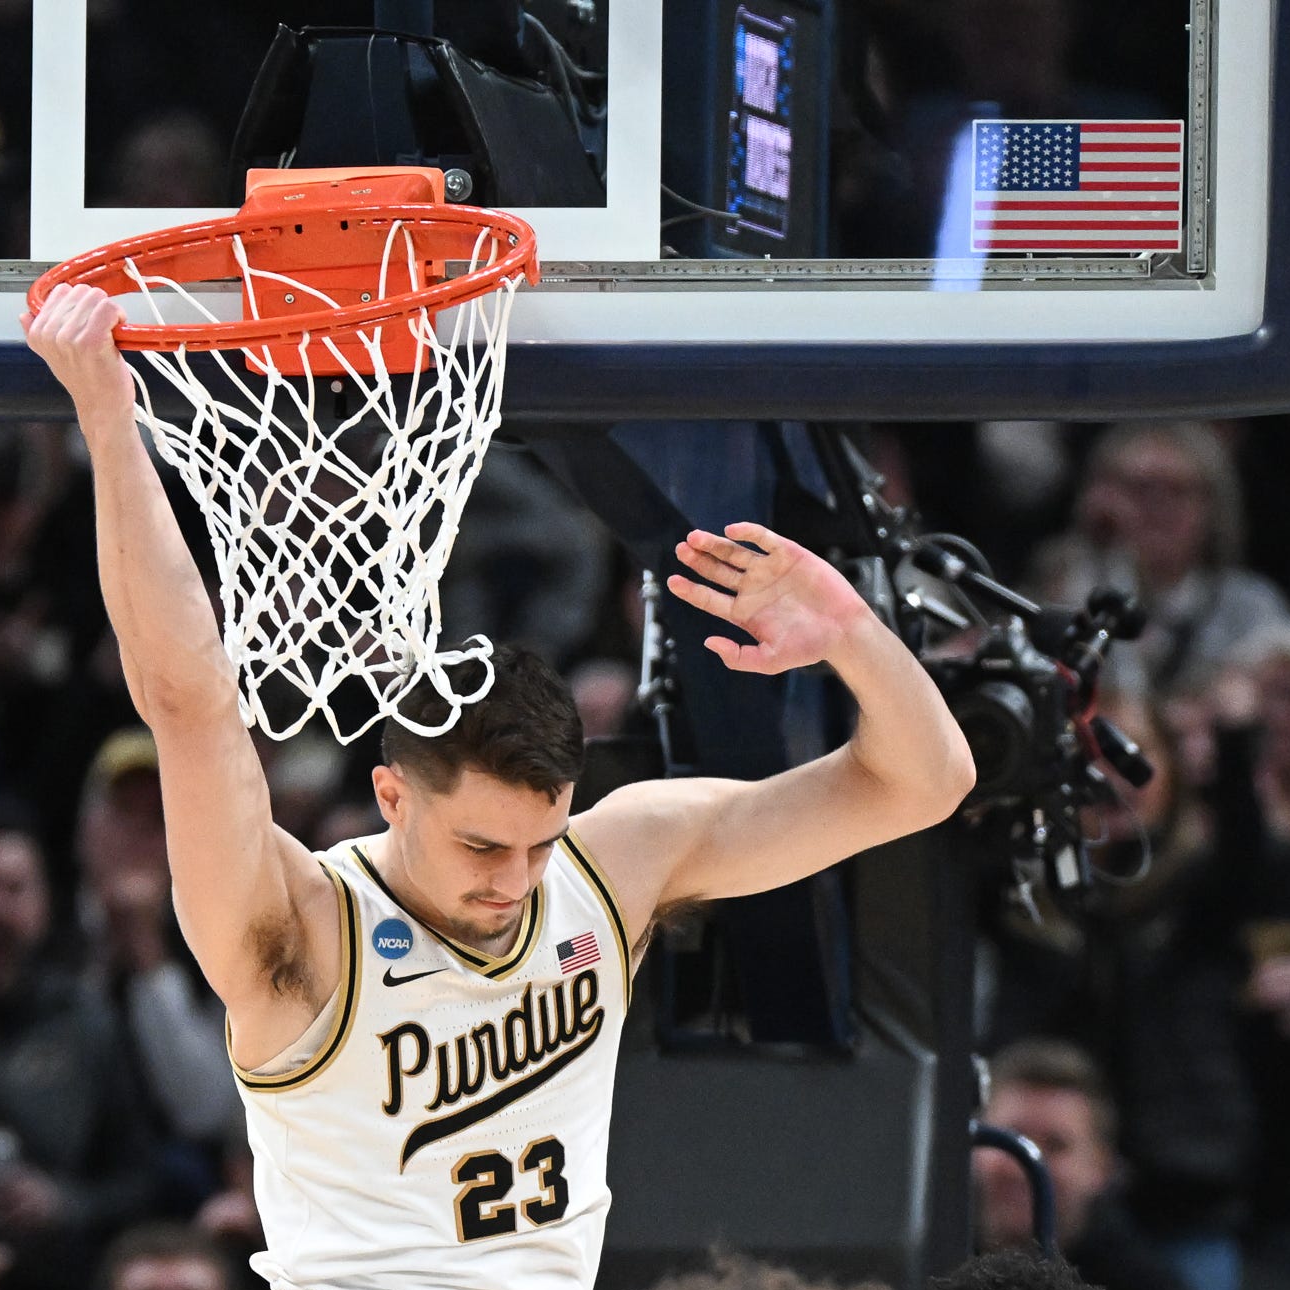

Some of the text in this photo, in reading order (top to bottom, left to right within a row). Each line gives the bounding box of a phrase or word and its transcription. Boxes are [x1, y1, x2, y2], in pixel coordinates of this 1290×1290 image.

[378, 937, 410, 950] NCAA
[376, 967, 605, 1117] Purdue
[451, 1134, 570, 1243] 23
